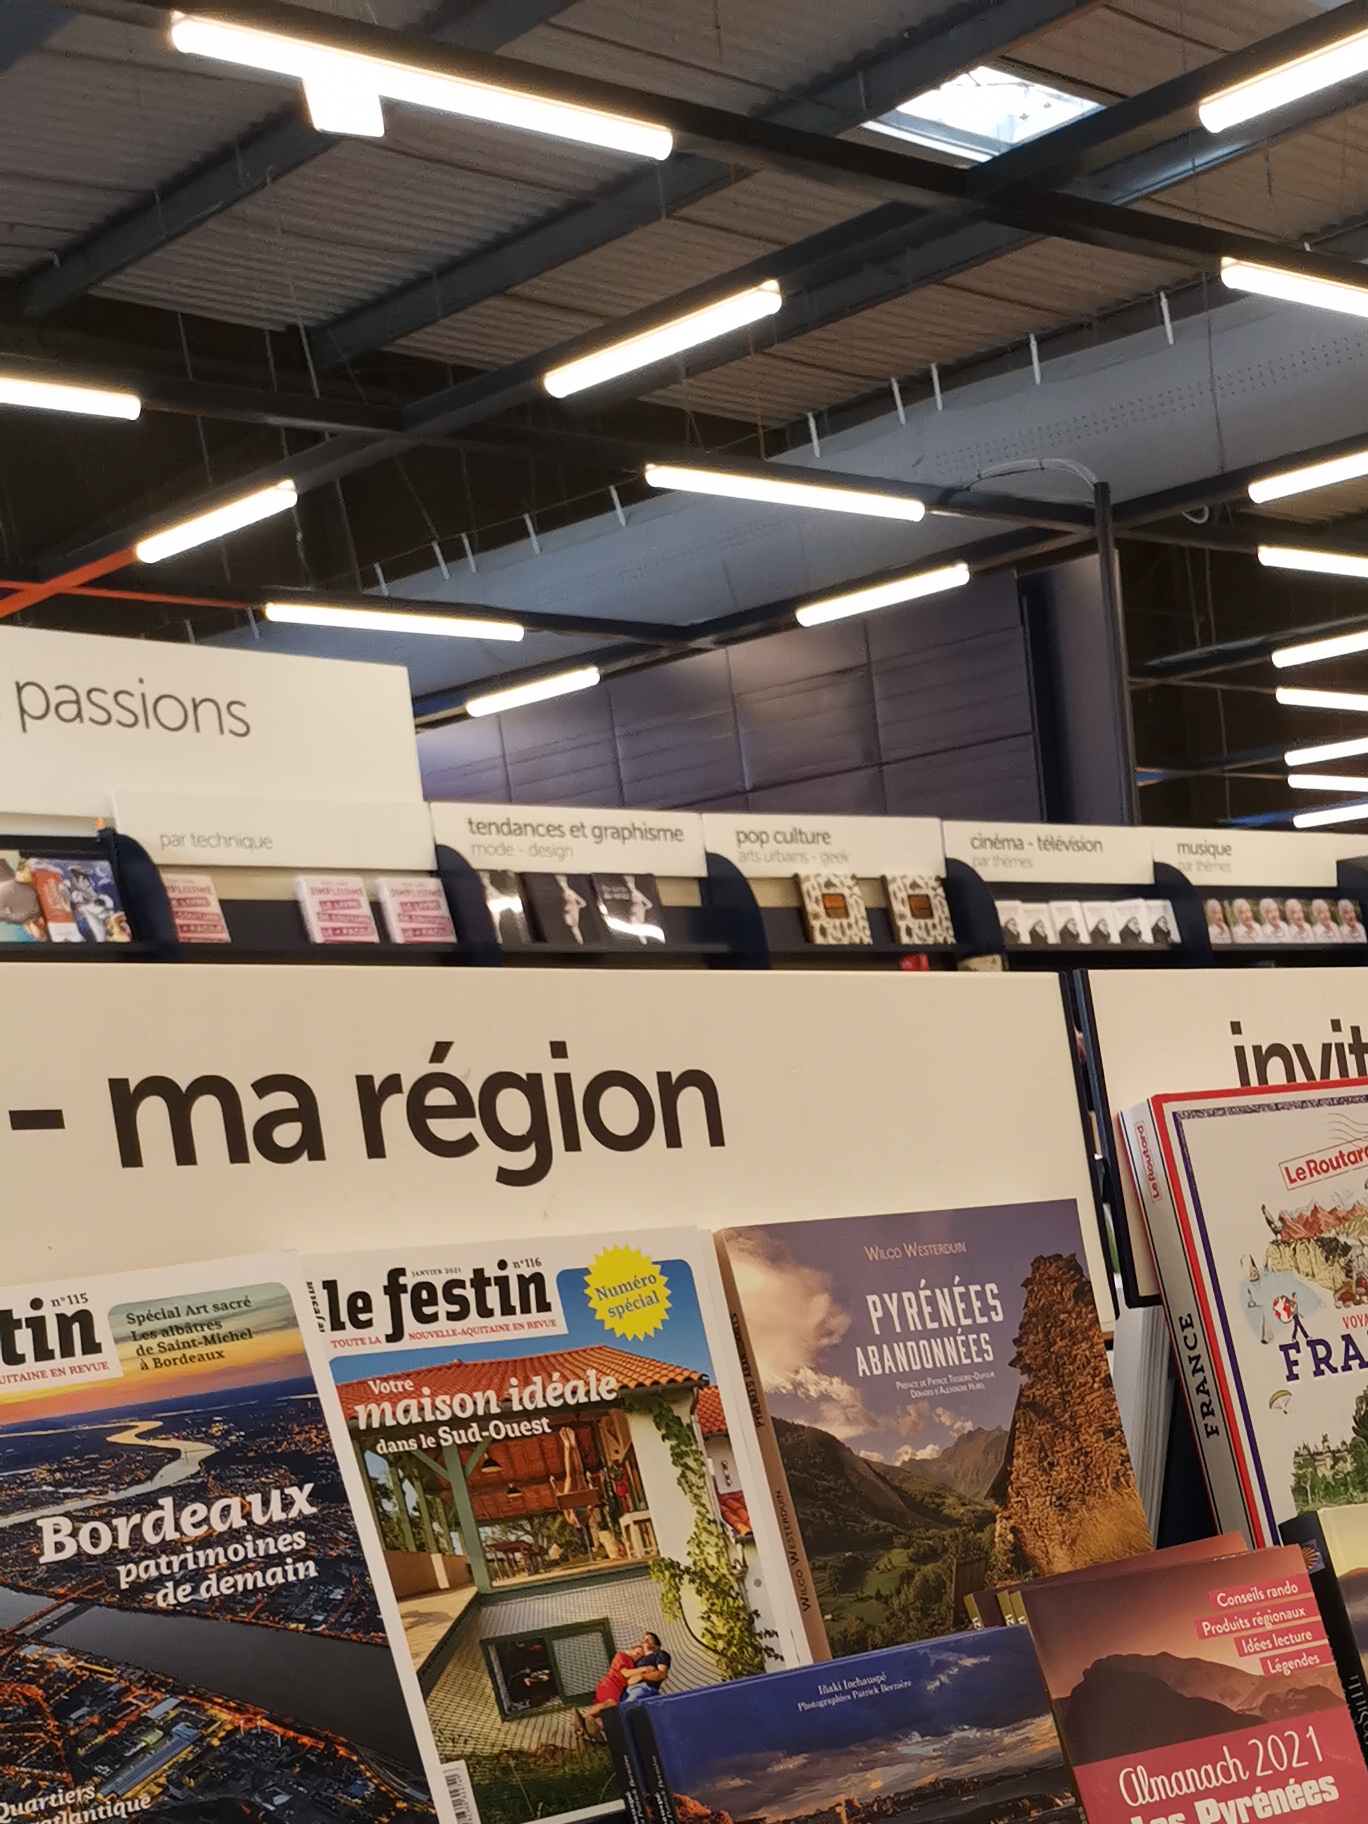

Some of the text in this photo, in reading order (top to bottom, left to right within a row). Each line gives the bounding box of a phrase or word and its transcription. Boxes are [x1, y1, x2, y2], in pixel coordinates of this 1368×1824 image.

[15, 677, 251, 738] passions
[160, 831, 273, 853] par technique
[467, 817, 684, 845] tendances et graphisme
[736, 826, 831, 849] pop culture
[970, 833, 1103, 854] cinéma télévision
[471, 842, 574, 860] mode design
[1176, 840, 1232, 861] musique
[108, 1073, 326, 1168] ma
[355, 1040, 726, 1187] région
[51, 1292, 89, 1308] n°115
[322, 1279, 374, 1331] le
[383, 1258, 553, 1344] festin
[595, 1271, 659, 1302] Numéro
[126, 1294, 252, 1328] Spécial Art sacré
[607, 1290, 662, 1321] spécial
[865, 1275, 1004, 1336] PYRÉNÉES
[131, 1316, 223, 1342] Les albâtres
[157, 1327, 254, 1354] Saint-Michel
[330, 1318, 557, 1350] TOUTE NOUVELLE-AQUITAINE REVUE
[68, 1360, 110, 1376] REVUE
[154, 1348, 226, 1369] Bordeaux
[855, 1328, 995, 1378] ABANDONNÉES
[367, 1377, 415, 1395] Votre
[1179, 1312, 1221, 1439] FRANCE
[354, 1369, 619, 1431] maison idéale
[376, 1416, 553, 1456] dans le Sud-Ouest
[36, 1481, 319, 1565] Bordeaux
[116, 1530, 307, 1589] patrimoines
[156, 1557, 320, 1608] de demain
[1216, 1581, 1299, 1608] Conseils rando
[1202, 1606, 1306, 1636] Produits régionaux
[1242, 1629, 1313, 1655] Idées lecture
[1268, 1652, 1320, 1677] Légendes
[1119, 1726, 1324, 1808] Almanach 2021
[0, 1784, 96, 1823] Quartiers
